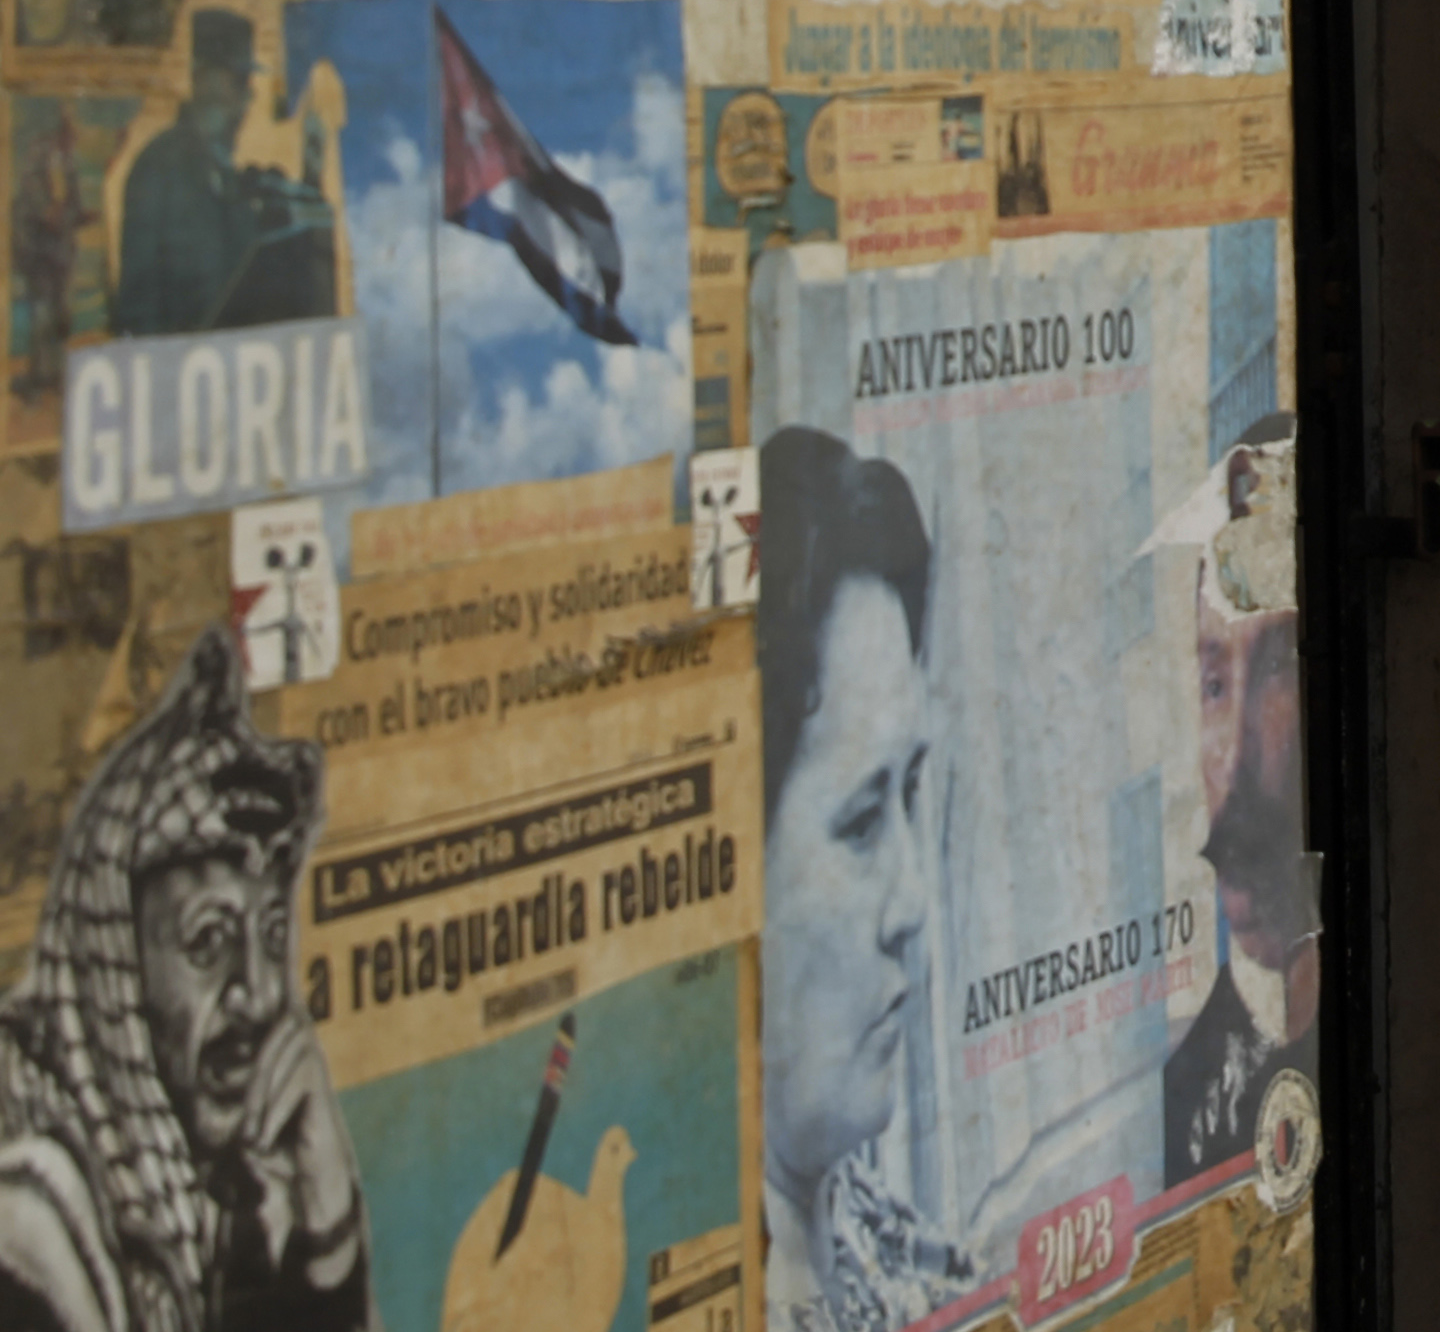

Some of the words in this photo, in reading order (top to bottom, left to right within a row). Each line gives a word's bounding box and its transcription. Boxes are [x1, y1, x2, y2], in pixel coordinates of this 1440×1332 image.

[1071, 120, 1219, 200] Granma
[855, 314, 1070, 400] ANIVERSARIO
[1083, 307, 1134, 364] 100
[68, 331, 366, 511] GLORIA
[346, 584, 523, 664] Compromiso
[529, 592, 546, 634] y
[548, 547, 690, 622] solidaridad
[316, 696, 370, 747] con
[379, 682, 407, 735] el
[413, 666, 491, 726] bravo
[321, 862, 371, 906] La
[379, 830, 514, 892] victoria
[522, 774, 696, 852] estratégica
[350, 871, 589, 1014] retaguardia
[601, 830, 738, 934] rebelde
[963, 926, 1141, 1035] ANIVERSARIO
[1150, 901, 1195, 957] 170
[1036, 1194, 1115, 1303] 2023
